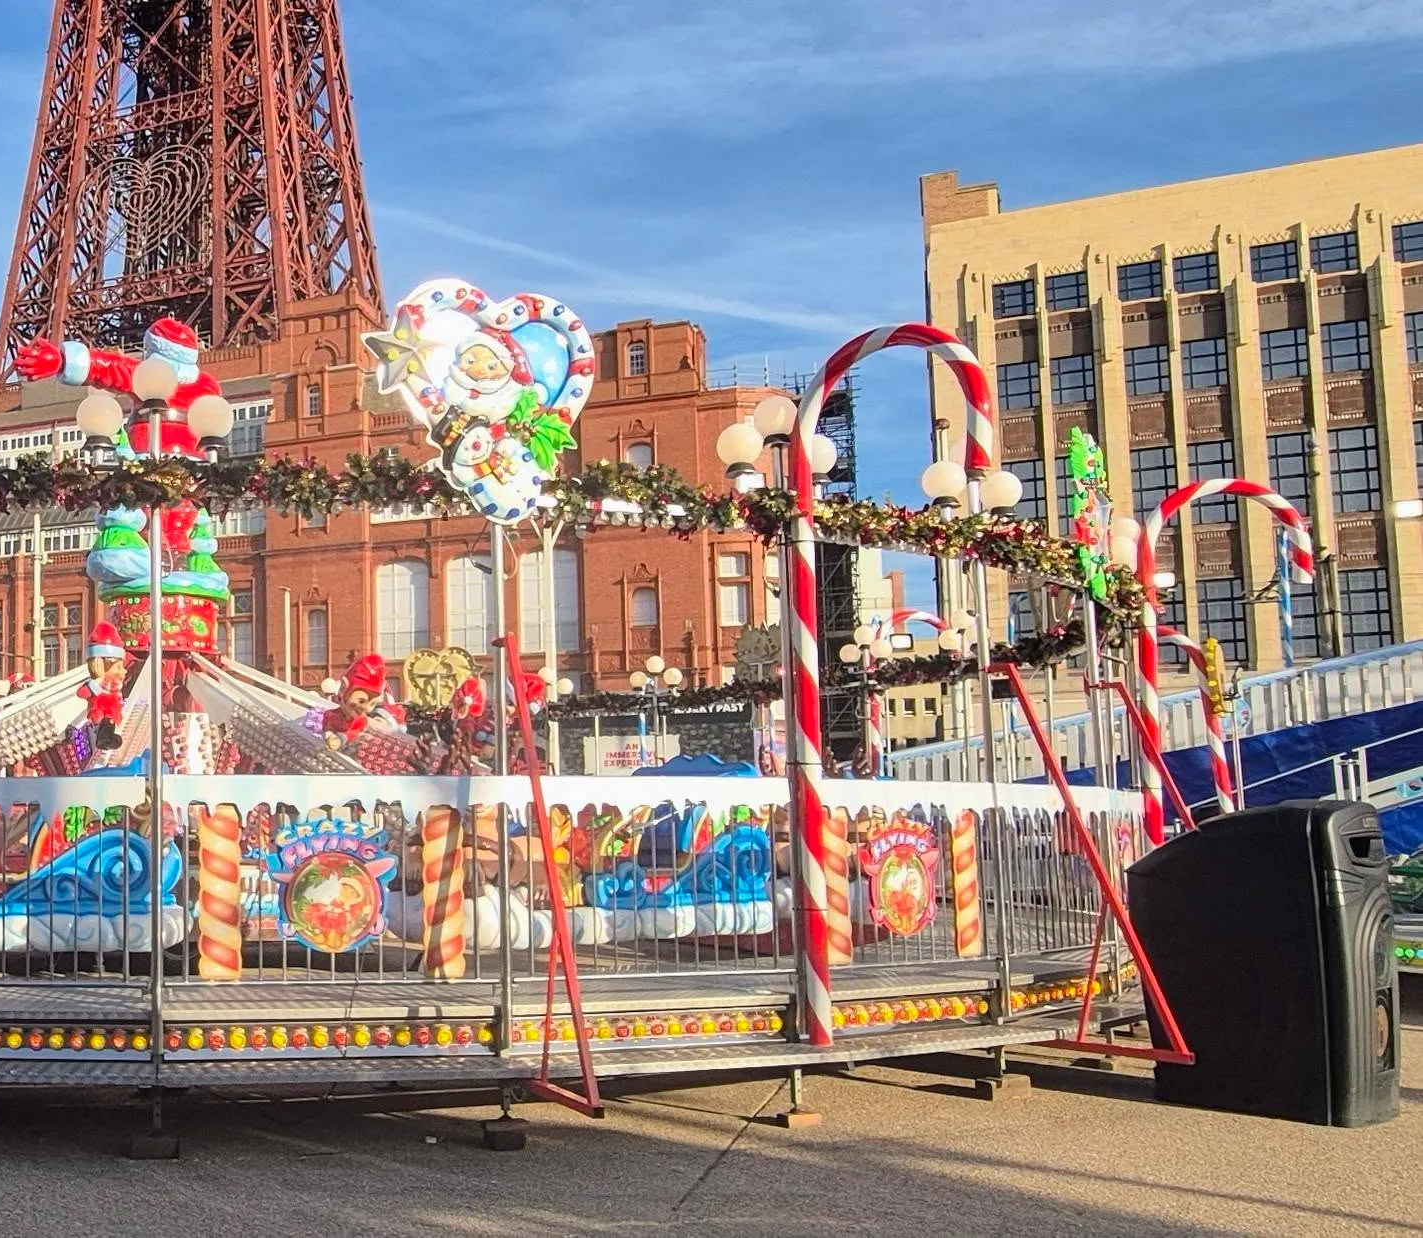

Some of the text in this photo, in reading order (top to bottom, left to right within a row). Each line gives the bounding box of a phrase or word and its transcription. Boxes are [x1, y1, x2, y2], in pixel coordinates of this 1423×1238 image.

[716, 702, 745, 713] PAST
[626, 743, 639, 751] AN
[605, 751, 658, 760] IMMERSV
[603, 759, 659, 768] EXPERIEC
[276, 818, 384, 846] CRAZY
[282, 835, 378, 870] FLYING
[873, 832, 928, 862] FLYING
